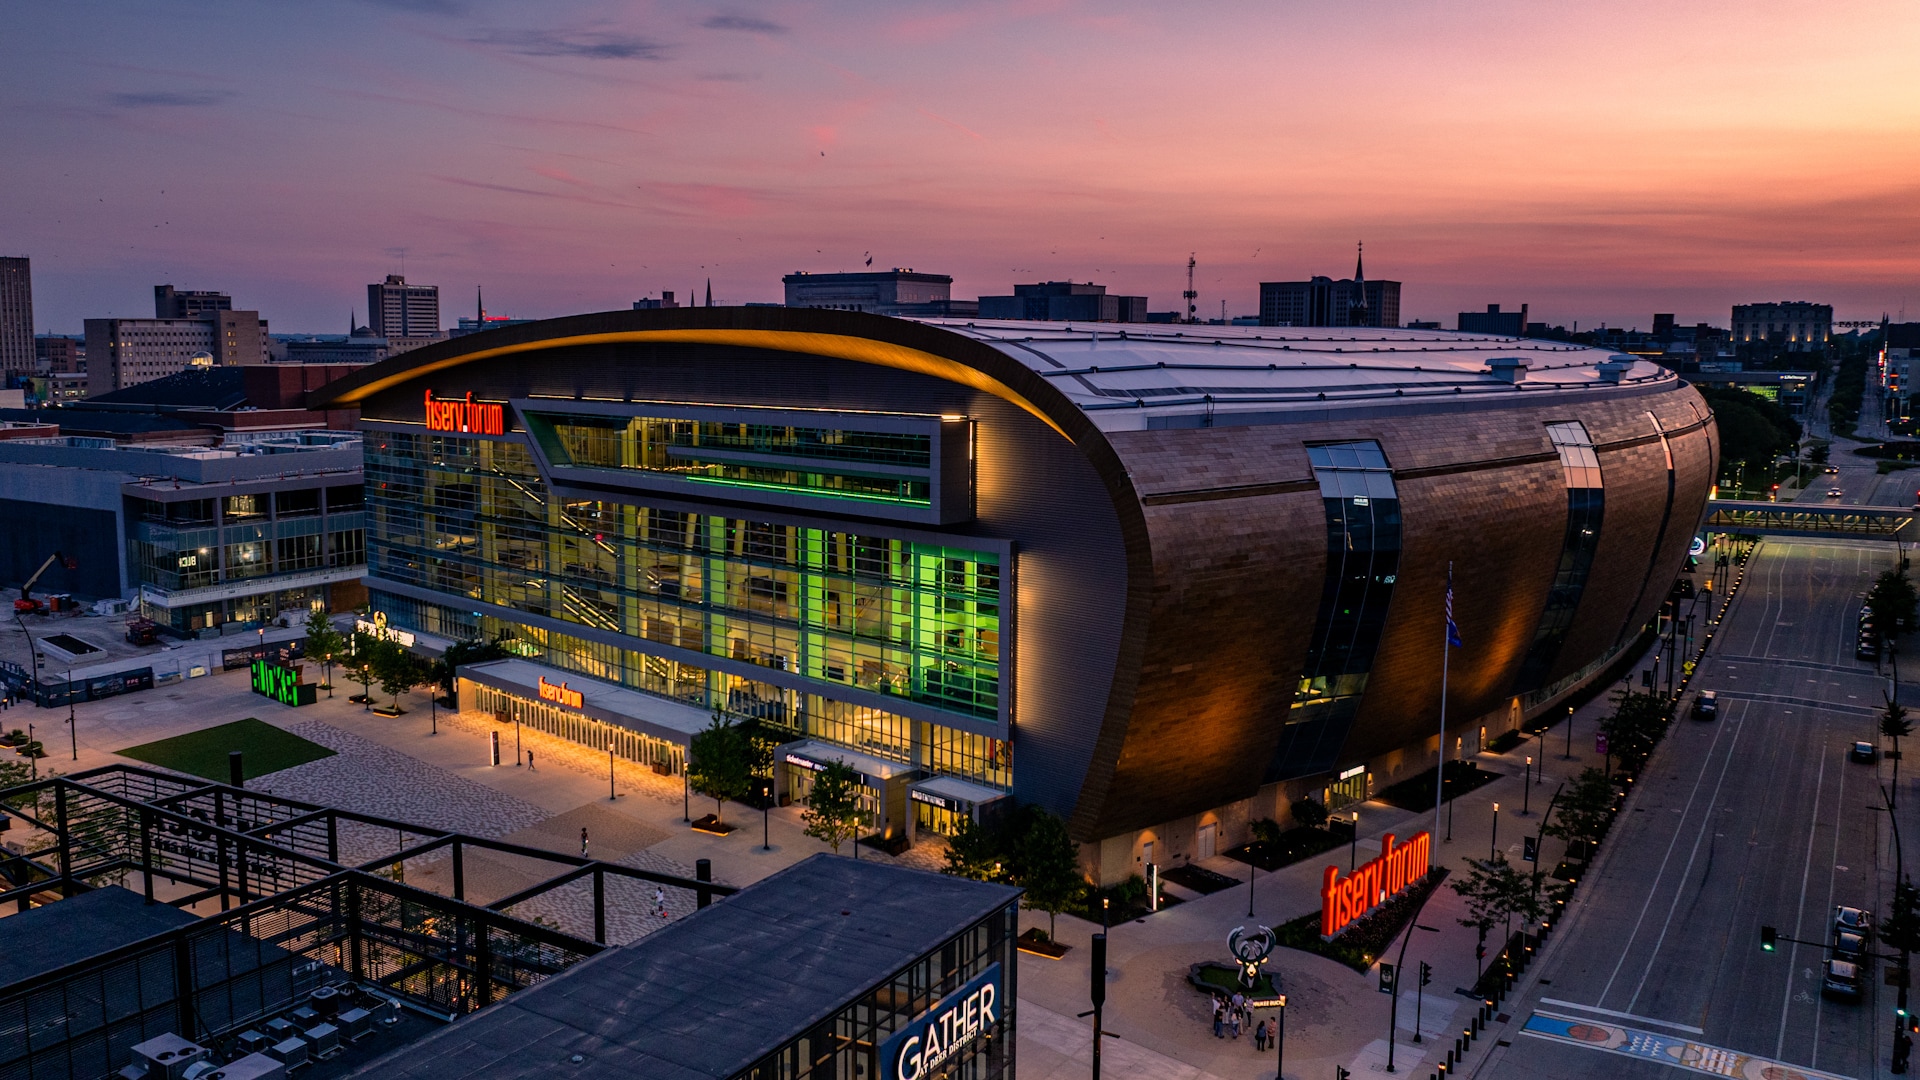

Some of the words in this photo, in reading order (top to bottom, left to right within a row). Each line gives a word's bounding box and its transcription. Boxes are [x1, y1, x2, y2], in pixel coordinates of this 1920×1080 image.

[898, 983, 995, 1080] GATHER
[919, 1064, 928, 1077] AT
[930, 1049, 947, 1069] DEER
[949, 1026, 978, 1055] DISTRICT
